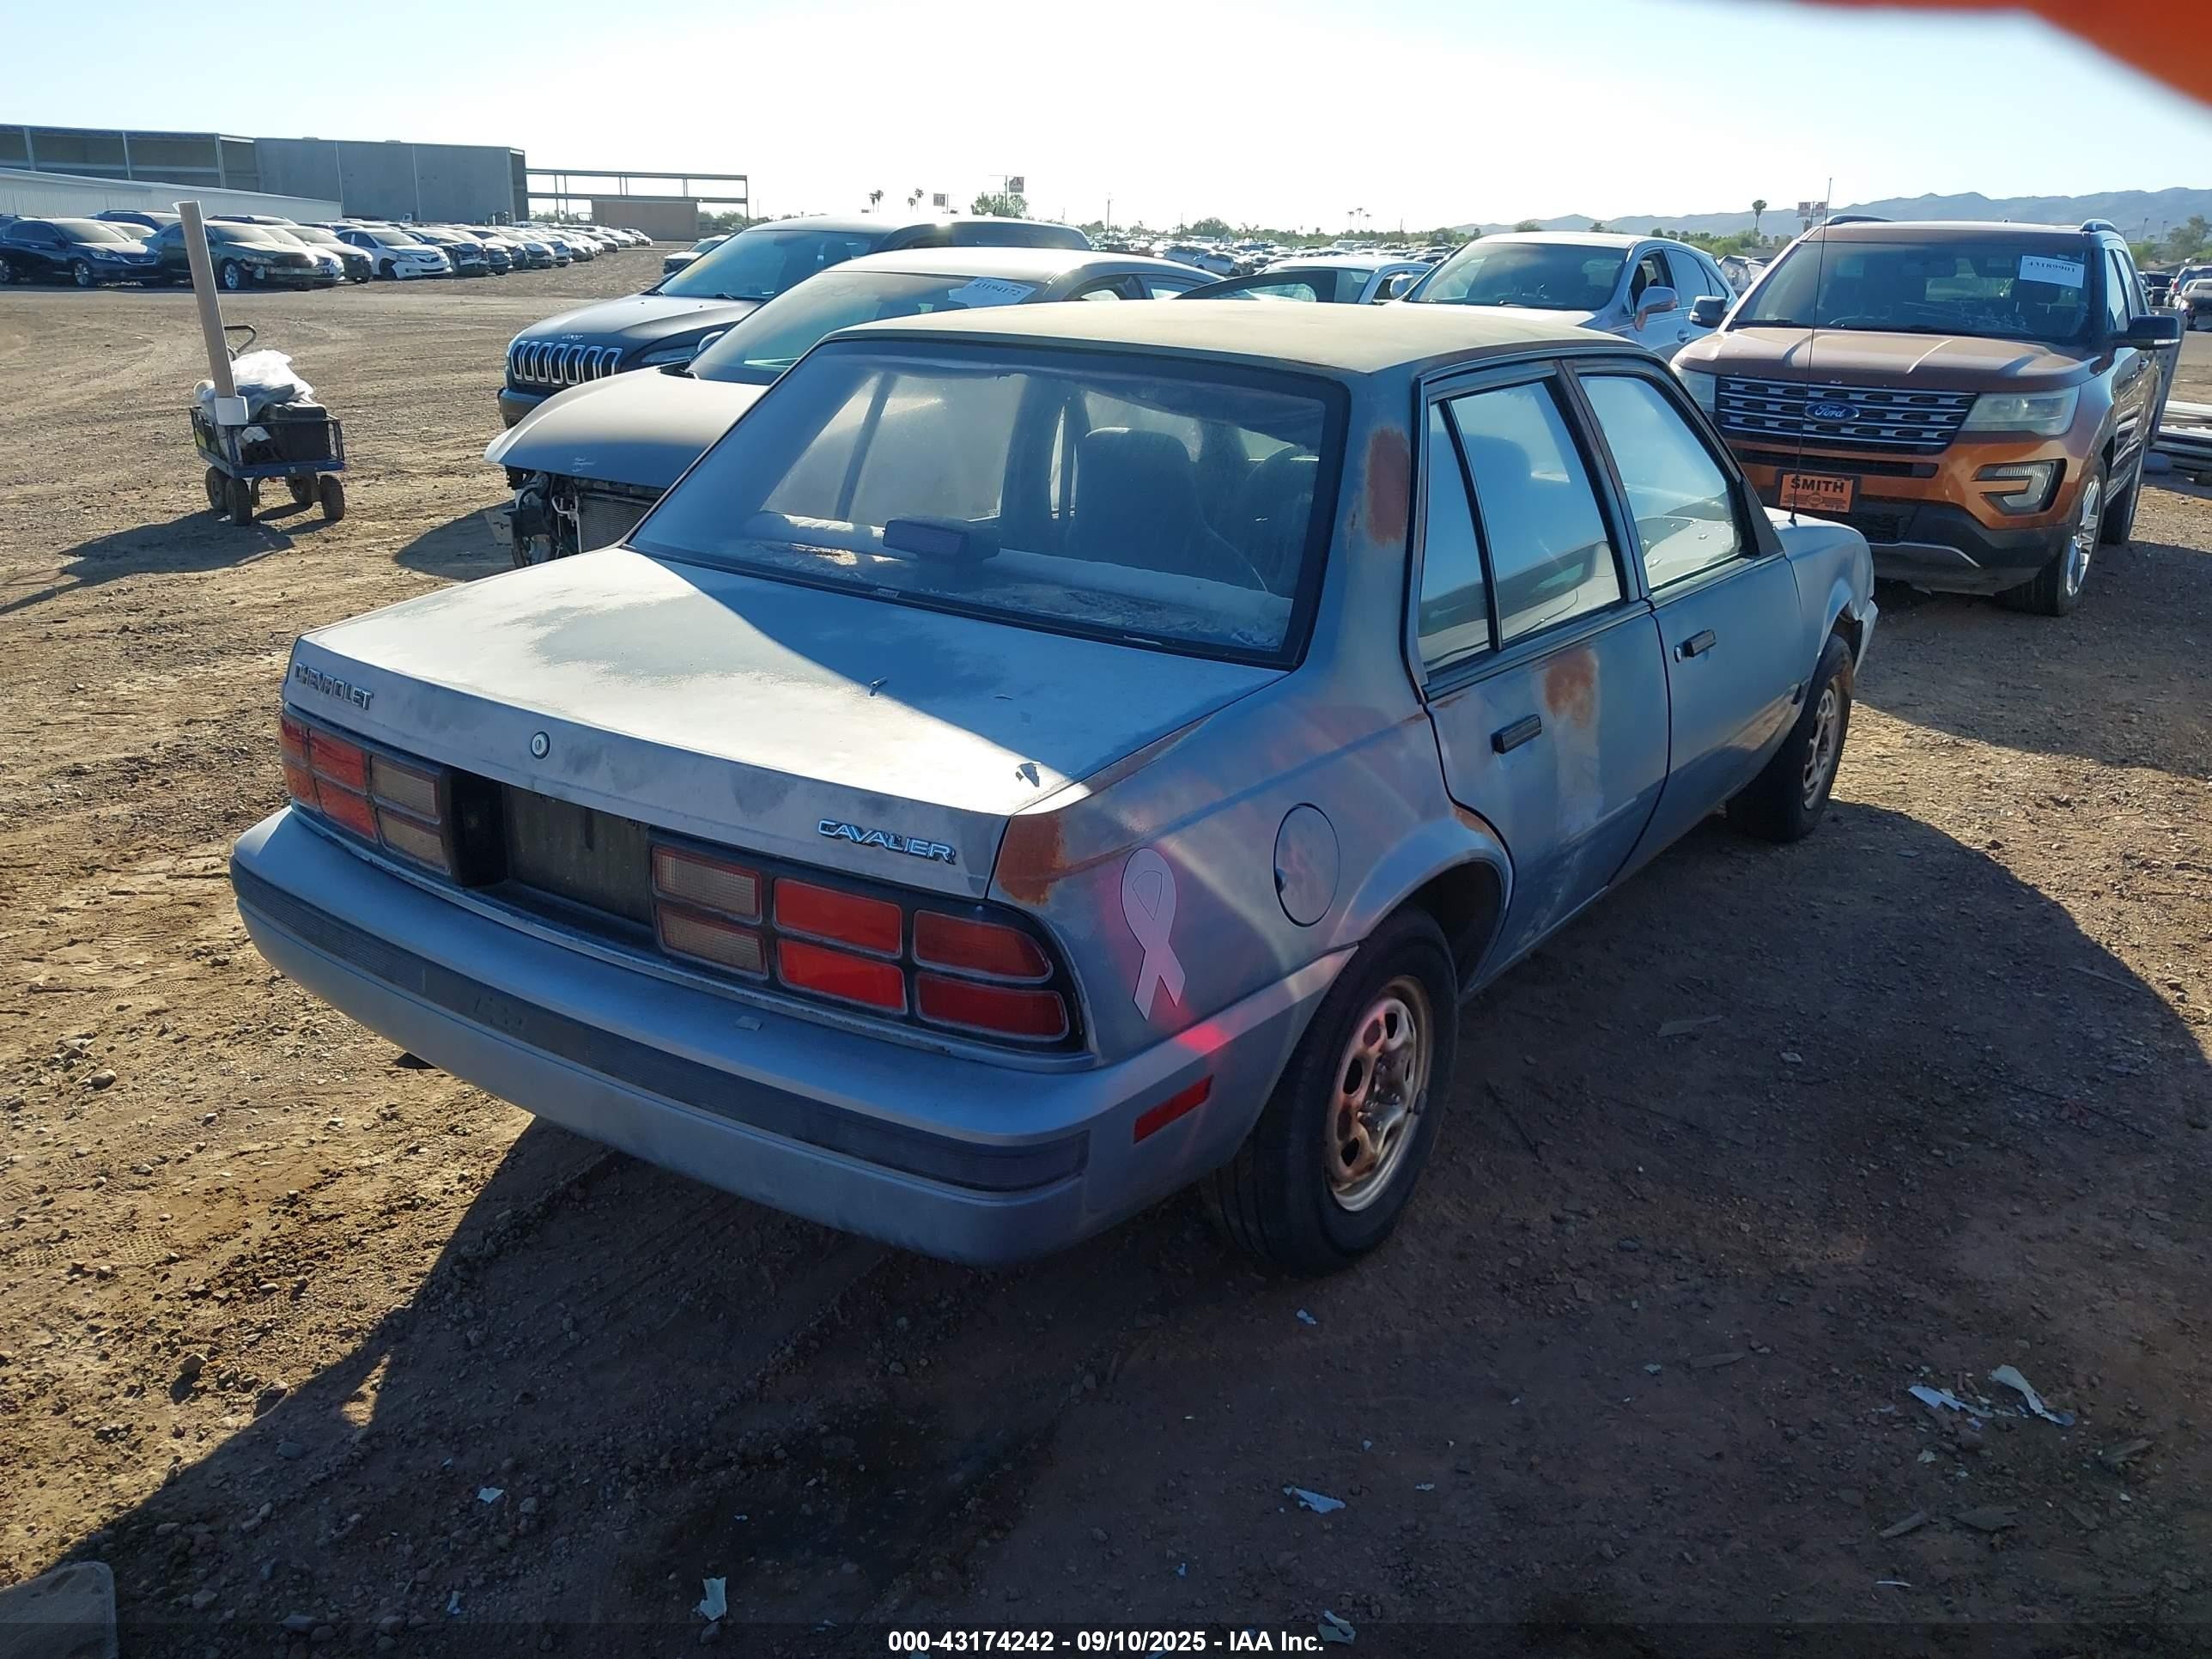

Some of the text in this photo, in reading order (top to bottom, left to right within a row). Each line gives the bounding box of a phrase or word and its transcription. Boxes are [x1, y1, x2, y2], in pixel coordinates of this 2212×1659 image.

[1814, 404, 1847, 418] Ford
[1790, 477, 1845, 493] SMITH
[295, 662, 373, 710] CHEVROLET
[818, 819, 956, 865] CAVALIER
